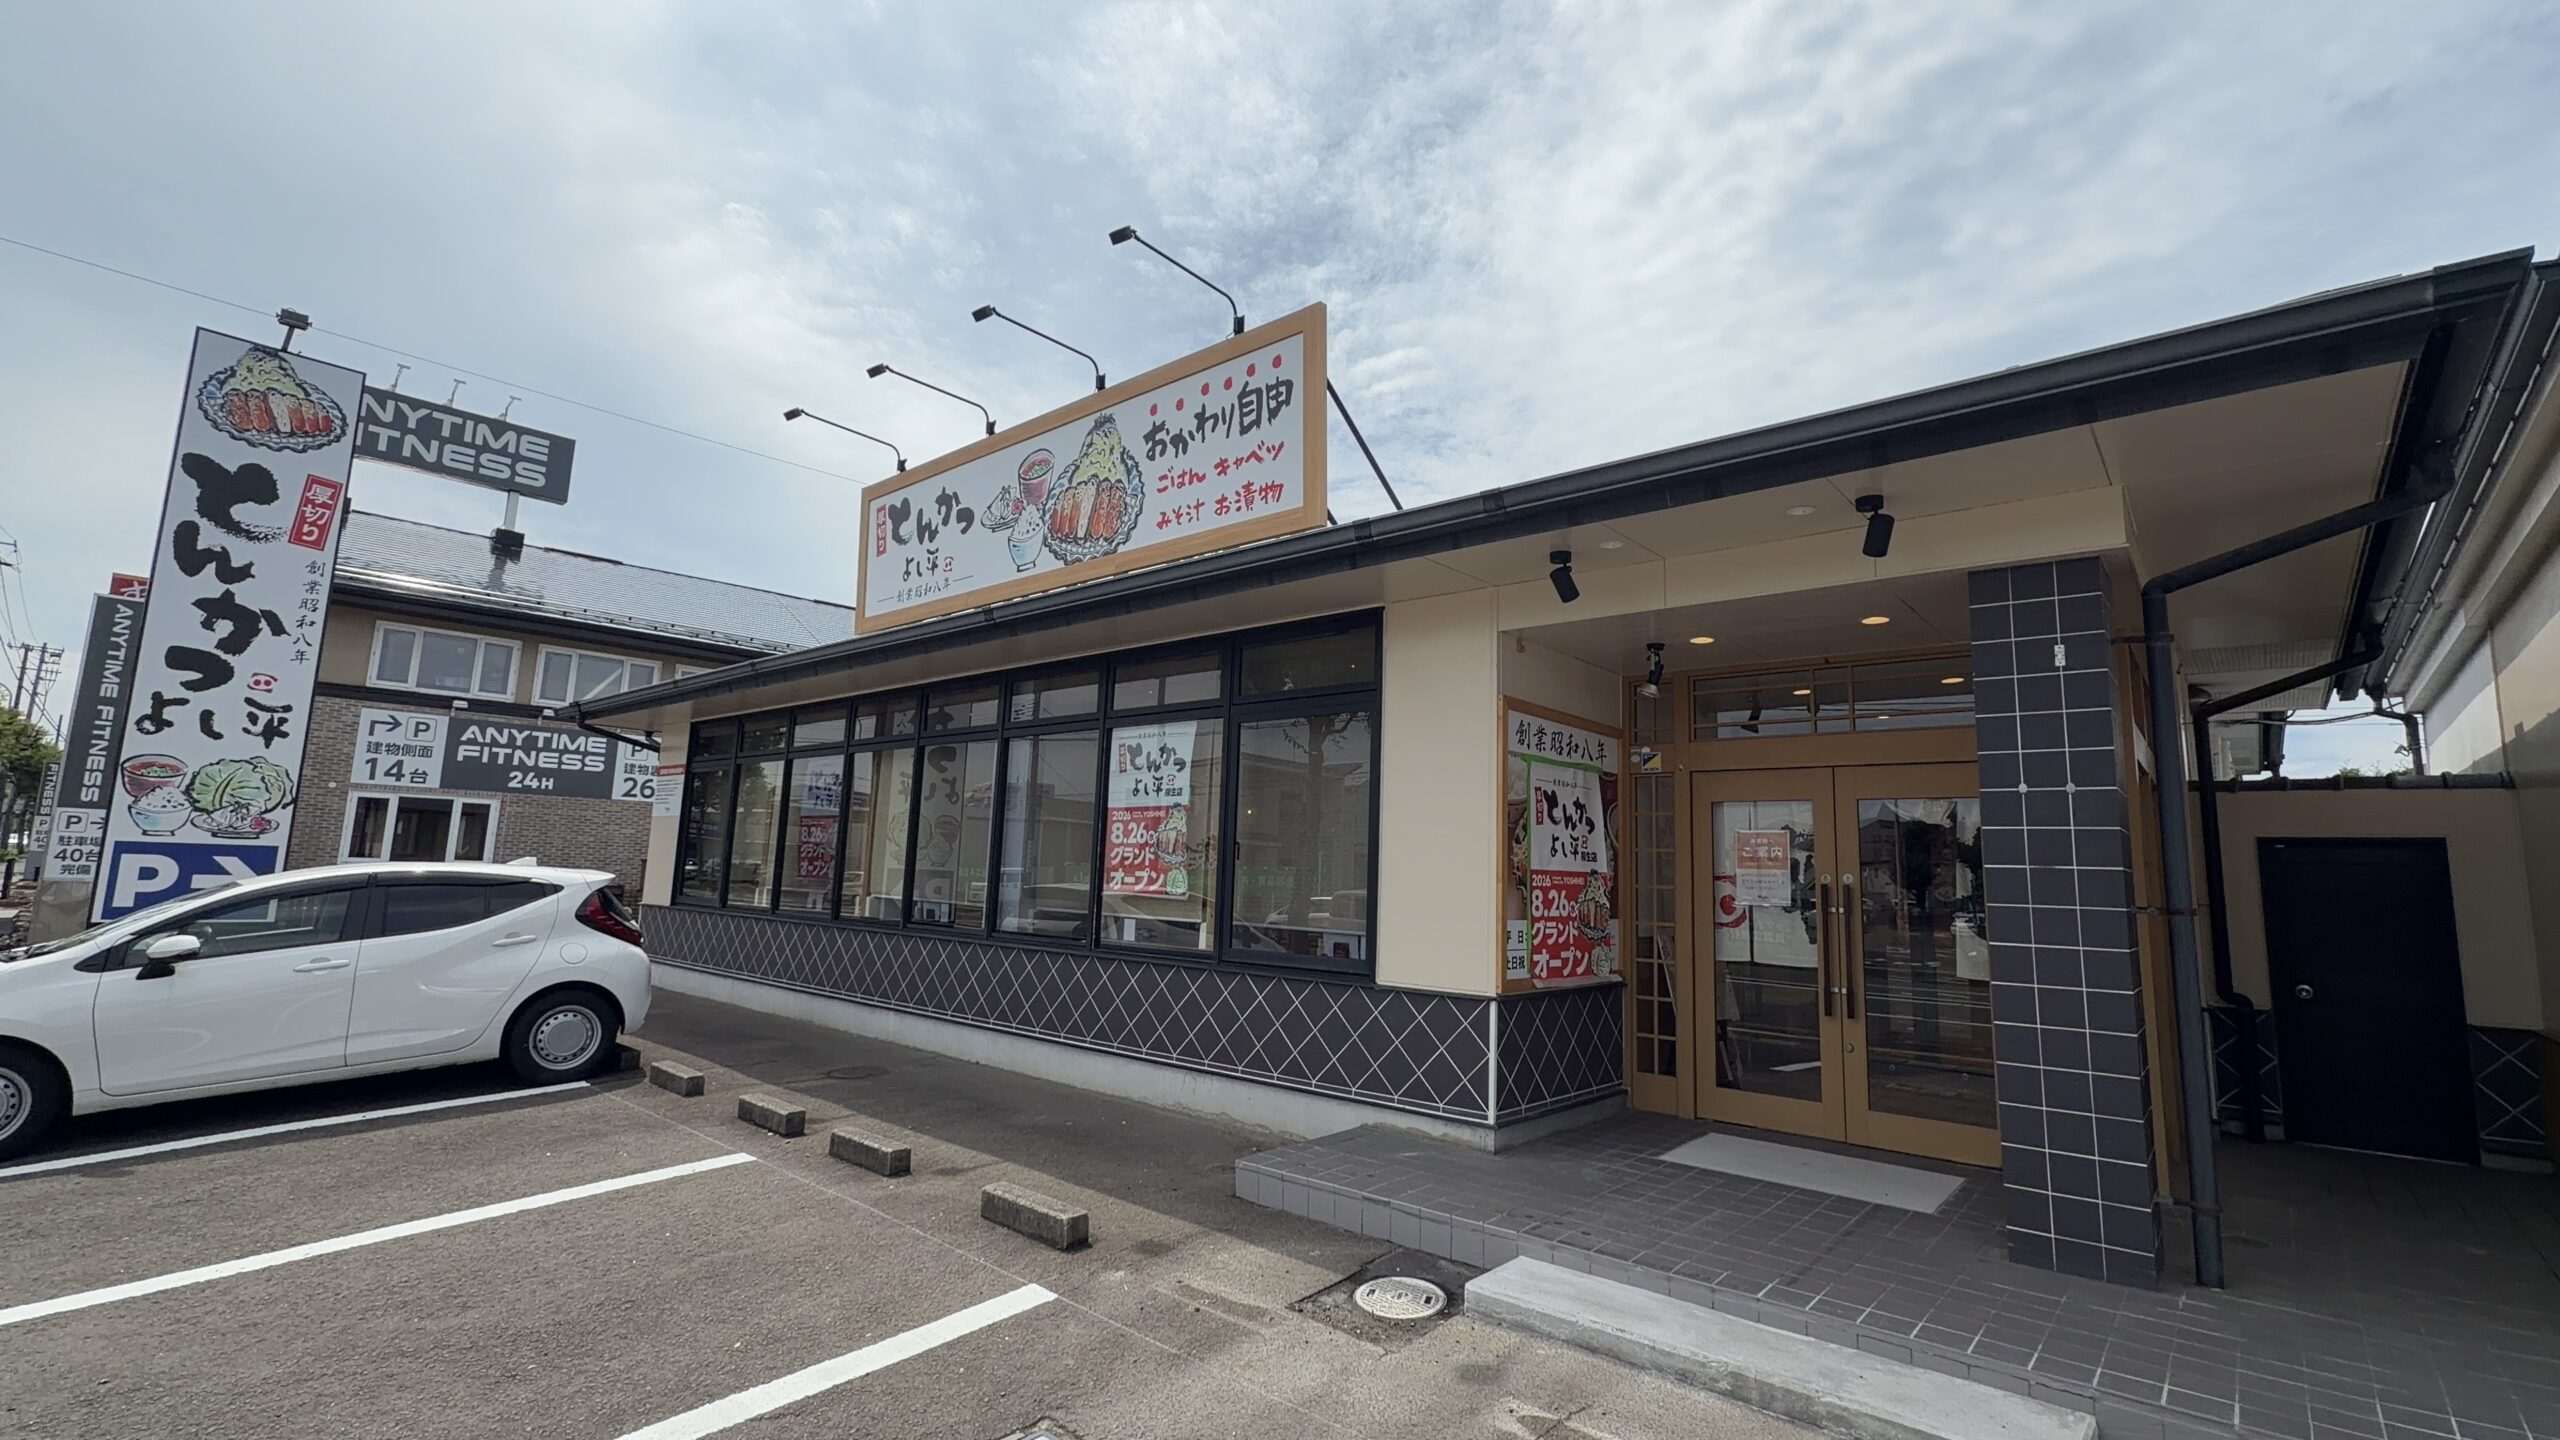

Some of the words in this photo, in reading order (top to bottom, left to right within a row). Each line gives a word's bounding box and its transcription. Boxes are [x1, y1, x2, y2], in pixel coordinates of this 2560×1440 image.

[1143, 376, 1294, 462] おかわり自由
[1156, 466, 1206, 494] ごはん
[1214, 440, 1285, 477] キャベツ
[301, 484, 335, 542] 厚切り
[887, 485, 975, 546] とんかつ
[1156, 498, 1205, 530] みそ汁
[1214, 480, 1284, 517] お漬物
[164, 452, 291, 692] とんかつ
[902, 547, 939, 583] よし平
[290, 560, 327, 666] 創業昭和八年
[97, 603, 135, 699] ANYTIME
[134, 690, 294, 750] よし平
[412, 721, 431, 739] P
[80, 704, 117, 802] FITNESS
[366, 741, 434, 759] 建物側面
[459, 725, 607, 754] ANYTIME
[1516, 720, 1608, 766] 創業昭和八年
[364, 758, 429, 784] 14台
[456, 746, 606, 772] FITNESS
[1127, 742, 1187, 773] とんかつ
[507, 771, 554, 791] 24H
[620, 777, 656, 799] 26
[1132, 775, 1164, 798] よし平
[65, 815, 83, 830] P
[1112, 811, 1132, 821] 2026
[1543, 789, 1595, 835] とんかつ
[1111, 822, 1147, 844] 8.26
[1551, 834, 1580, 861] よし平
[54, 847, 100, 863] 40台
[1110, 846, 1156, 866] グランド
[60, 864, 92, 876] 完備
[112, 853, 180, 908] P
[1109, 868, 1166, 892] オープン
[1532, 874, 1552, 887] 2026
[1532, 889, 1568, 918] 8.26
[1532, 920, 1579, 945] グランド
[1532, 946, 1589, 979] オープン
